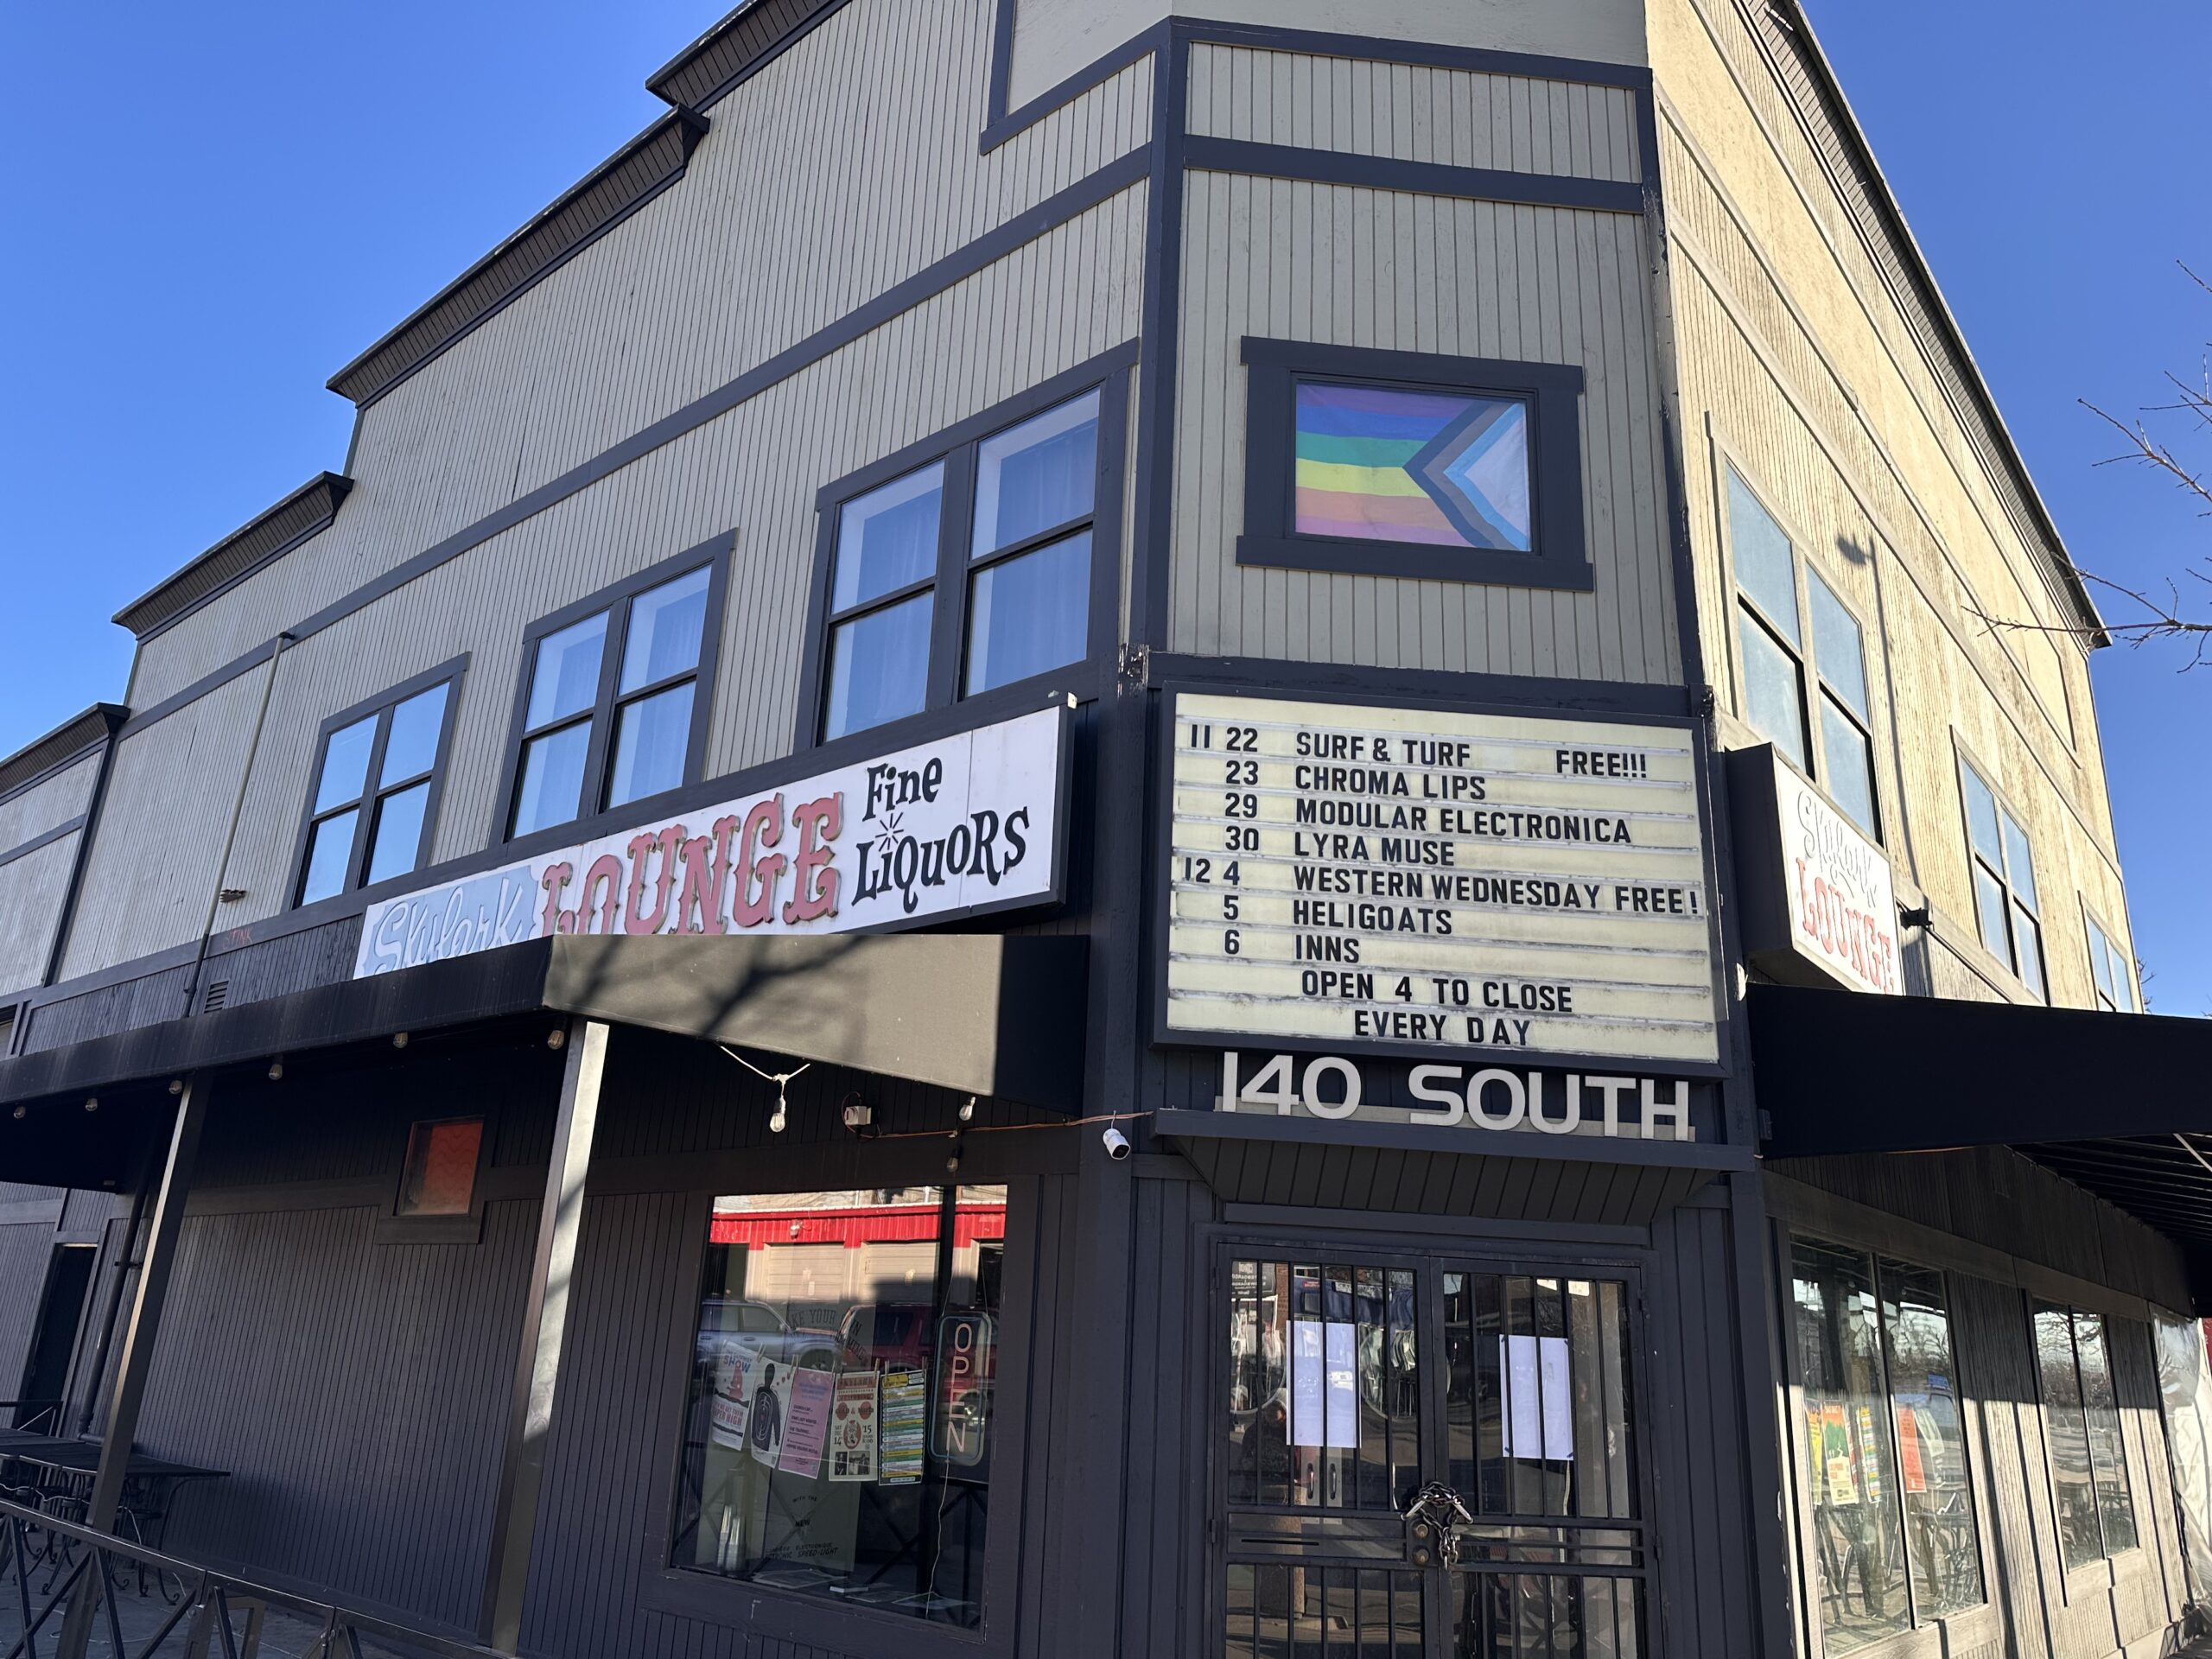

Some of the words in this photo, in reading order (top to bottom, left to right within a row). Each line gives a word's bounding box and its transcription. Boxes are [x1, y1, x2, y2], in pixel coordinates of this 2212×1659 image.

[1192, 725, 1210, 748] 11
[1227, 728, 1257, 752] 22
[1297, 733, 1363, 760] SURF
[1373, 738, 1390, 761] &
[1402, 740, 1470, 766] TURF
[1556, 750, 1645, 776] FREE!!!
[862, 757, 943, 822] Fine
[1226, 760, 1258, 785] 23
[1296, 766, 1408, 796] CHROMA
[1424, 774, 1484, 799] LIPS
[1225, 793, 1256, 817] 29
[1297, 798, 1426, 830] MODULAR
[1440, 809, 1630, 842] ELECTRONICA
[1226, 826, 1258, 850] 30
[1295, 832, 1369, 860] LYRA
[1382, 838, 1453, 866] MUSE
[374, 877, 524, 976] Skylark
[542, 791, 844, 935] LOUNGE
[1185, 857, 1210, 883] 12
[1224, 861, 1239, 885] 4
[1294, 866, 1422, 897] WESTERN
[1431, 875, 1599, 908] WEDNESDAY
[1224, 895, 1238, 919] 5
[1294, 900, 1452, 934] HELIGOATS
[1796, 857, 1895, 994] LOUNGE
[1225, 930, 1239, 954] 6
[1296, 935, 1358, 963] INNS
[1302, 970, 1373, 999] OPEN
[1395, 976, 1412, 1001] 4
[1433, 978, 1469, 1006] TO
[1483, 982, 1572, 1012] CLOSE
[1354, 1010, 1447, 1041] EVERY
[1468, 1018, 1530, 1046] DAY
[1223, 1052, 1361, 1120] 140
[1408, 1065, 1689, 1141] SOUTH
[722, 1353, 751, 1375] SHOW
[945, 1323, 972, 1452] OPEN
